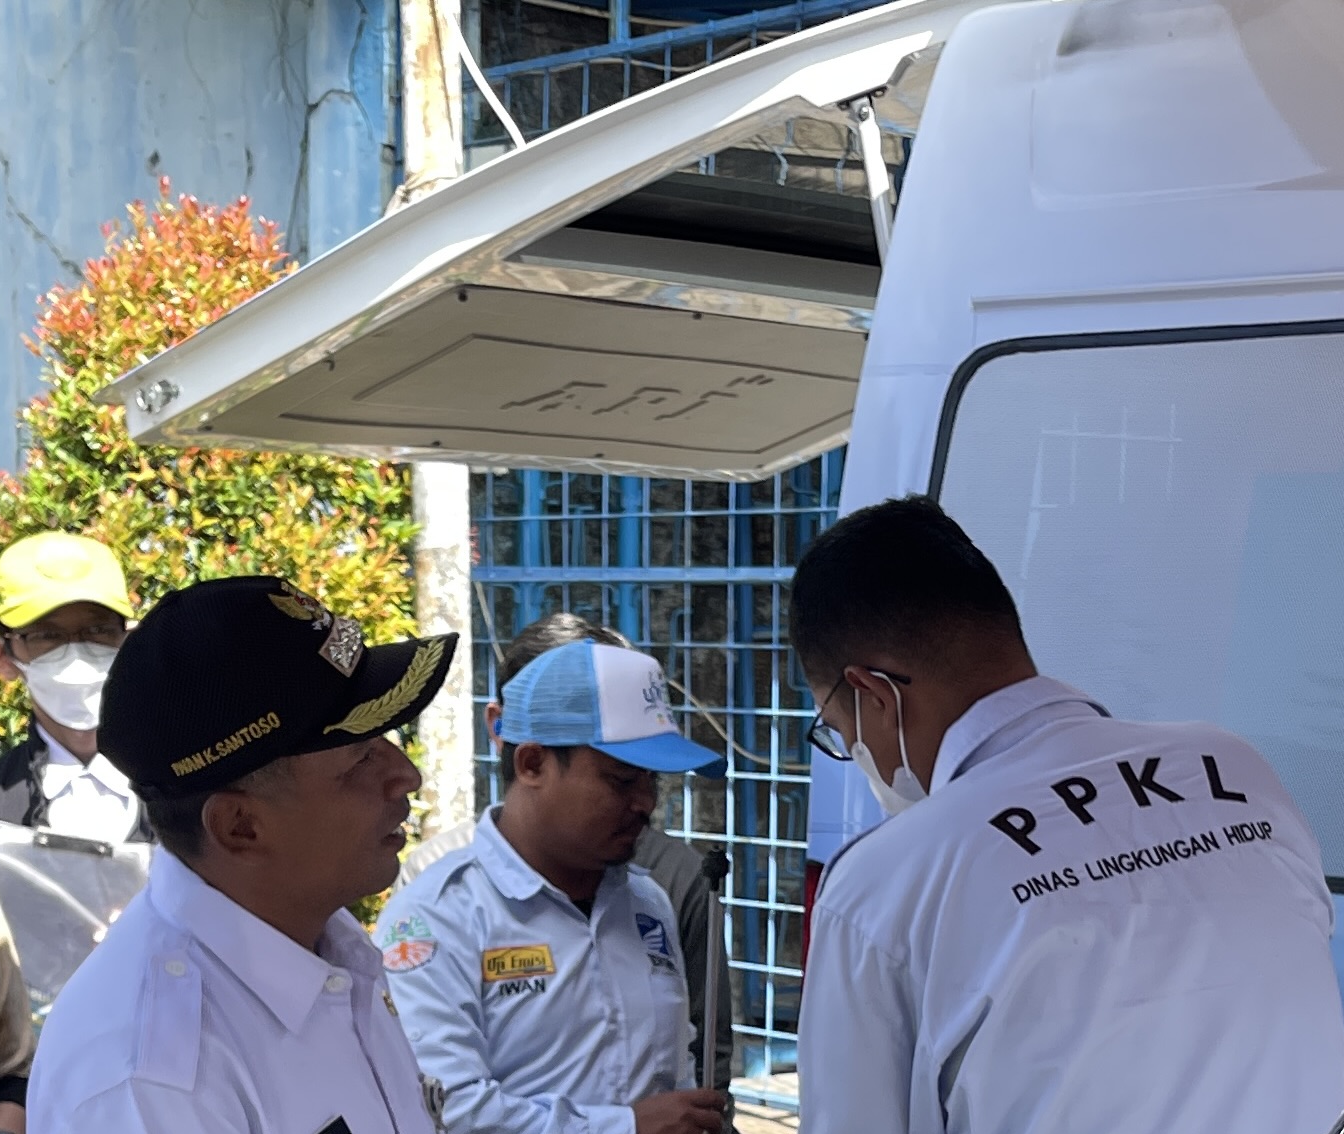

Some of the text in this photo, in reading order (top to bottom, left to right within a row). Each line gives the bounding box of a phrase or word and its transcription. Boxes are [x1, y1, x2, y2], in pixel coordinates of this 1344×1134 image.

[1011, 820, 1273, 904] DINAS LINGKUNGAN HIDUP
[499, 977, 546, 997] IWAN
